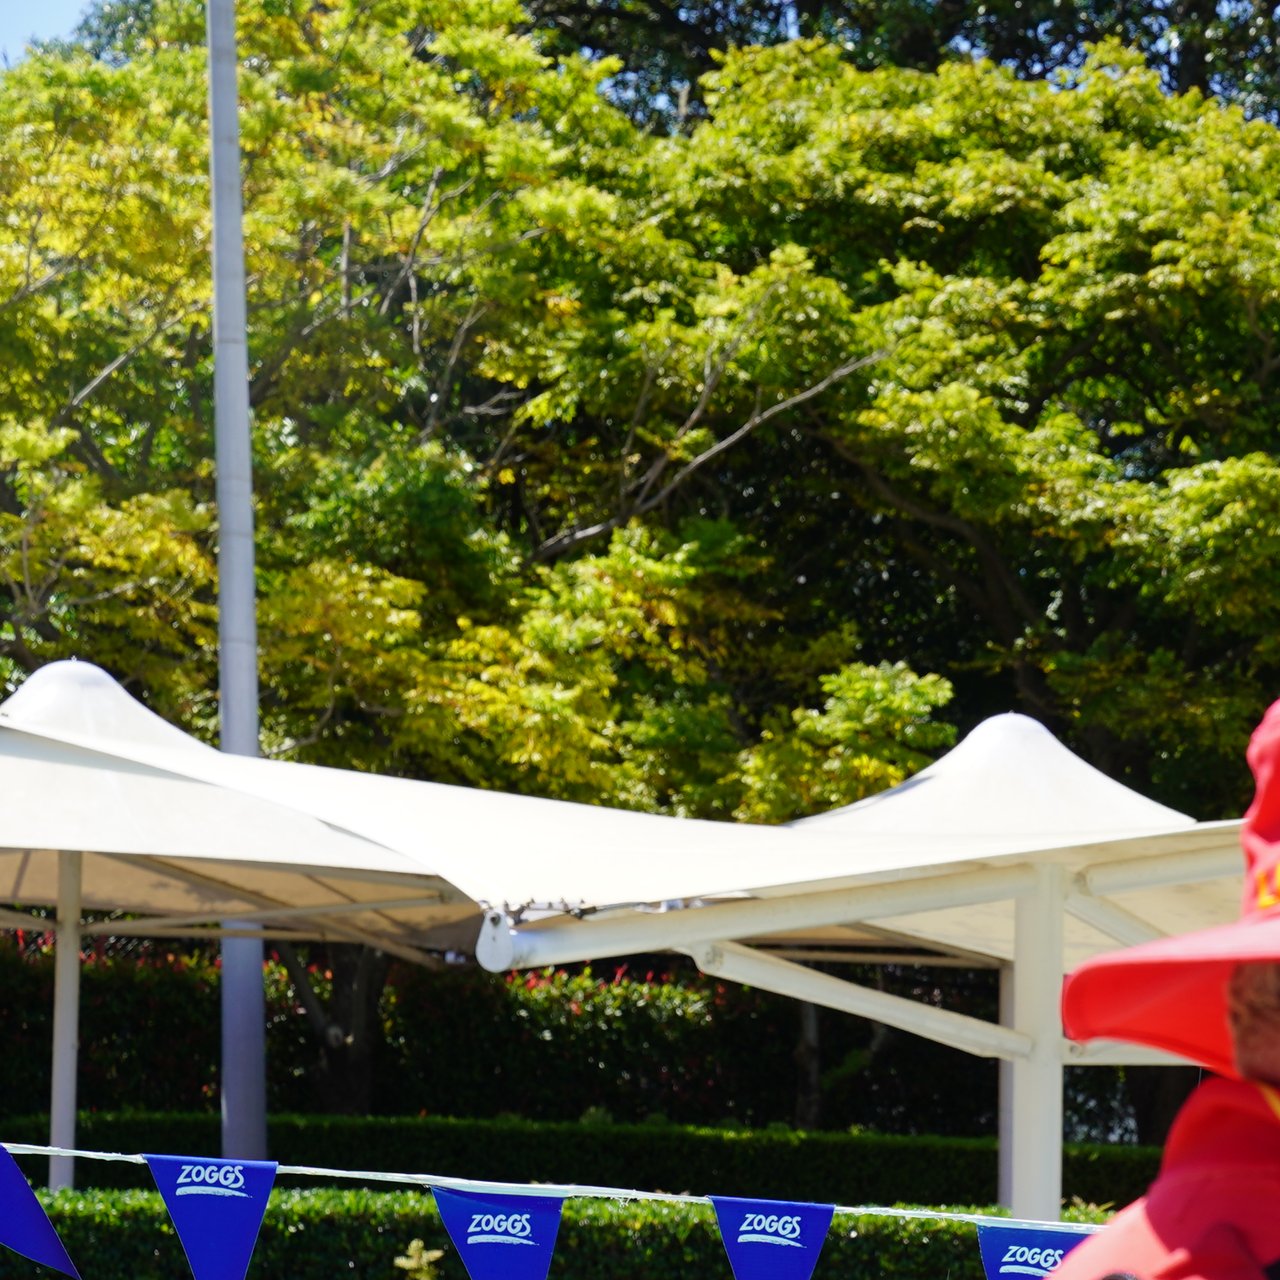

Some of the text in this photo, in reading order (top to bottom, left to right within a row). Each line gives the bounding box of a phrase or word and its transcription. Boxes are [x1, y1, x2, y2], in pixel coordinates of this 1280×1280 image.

[177, 1165, 244, 1188] ZOGGS
[468, 1214, 531, 1236] ZOGGS
[739, 1213, 801, 1238] ZOGGS
[1002, 1246, 1062, 1270] ZOGGS
